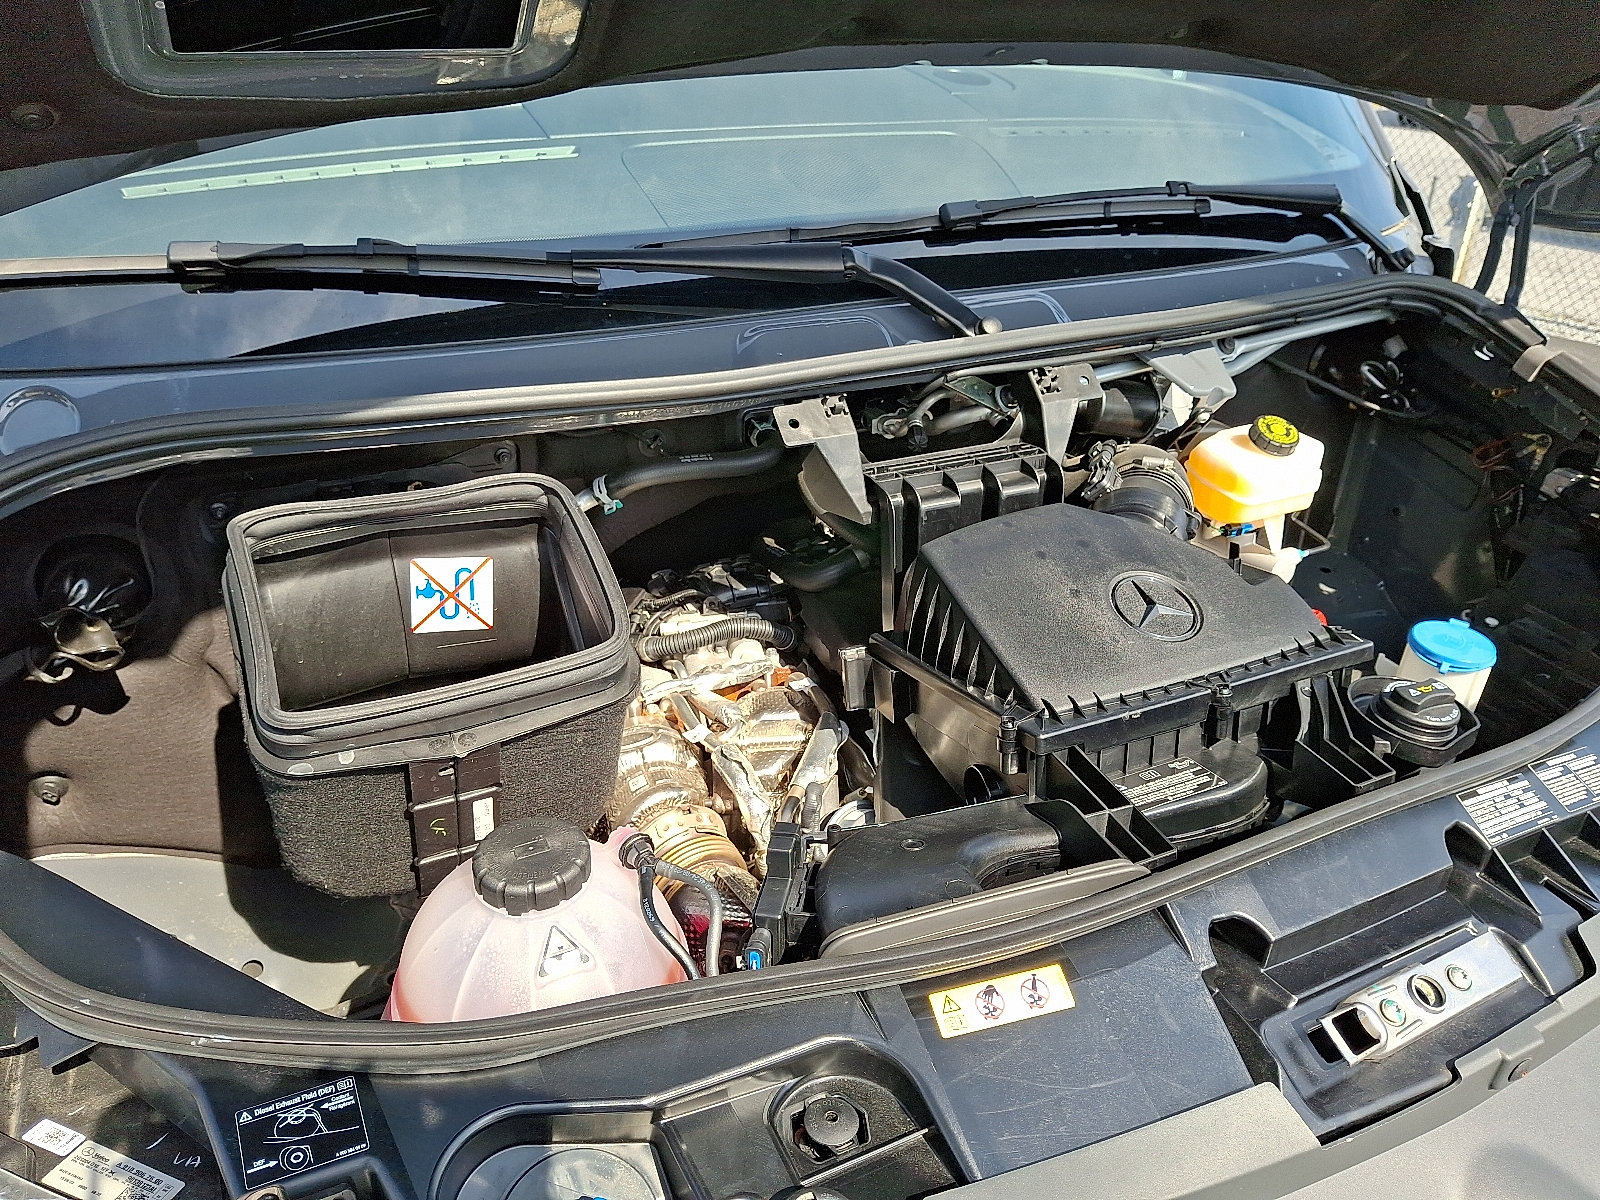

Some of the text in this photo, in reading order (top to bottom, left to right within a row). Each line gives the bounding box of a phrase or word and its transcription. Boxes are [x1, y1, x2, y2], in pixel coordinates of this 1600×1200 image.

[254, 1104, 274, 1116] Diesel
[276, 1097, 301, 1109] Exhaust
[318, 1086, 336, 1097] (DEF)
[253, 1158, 266, 1168] DEF
